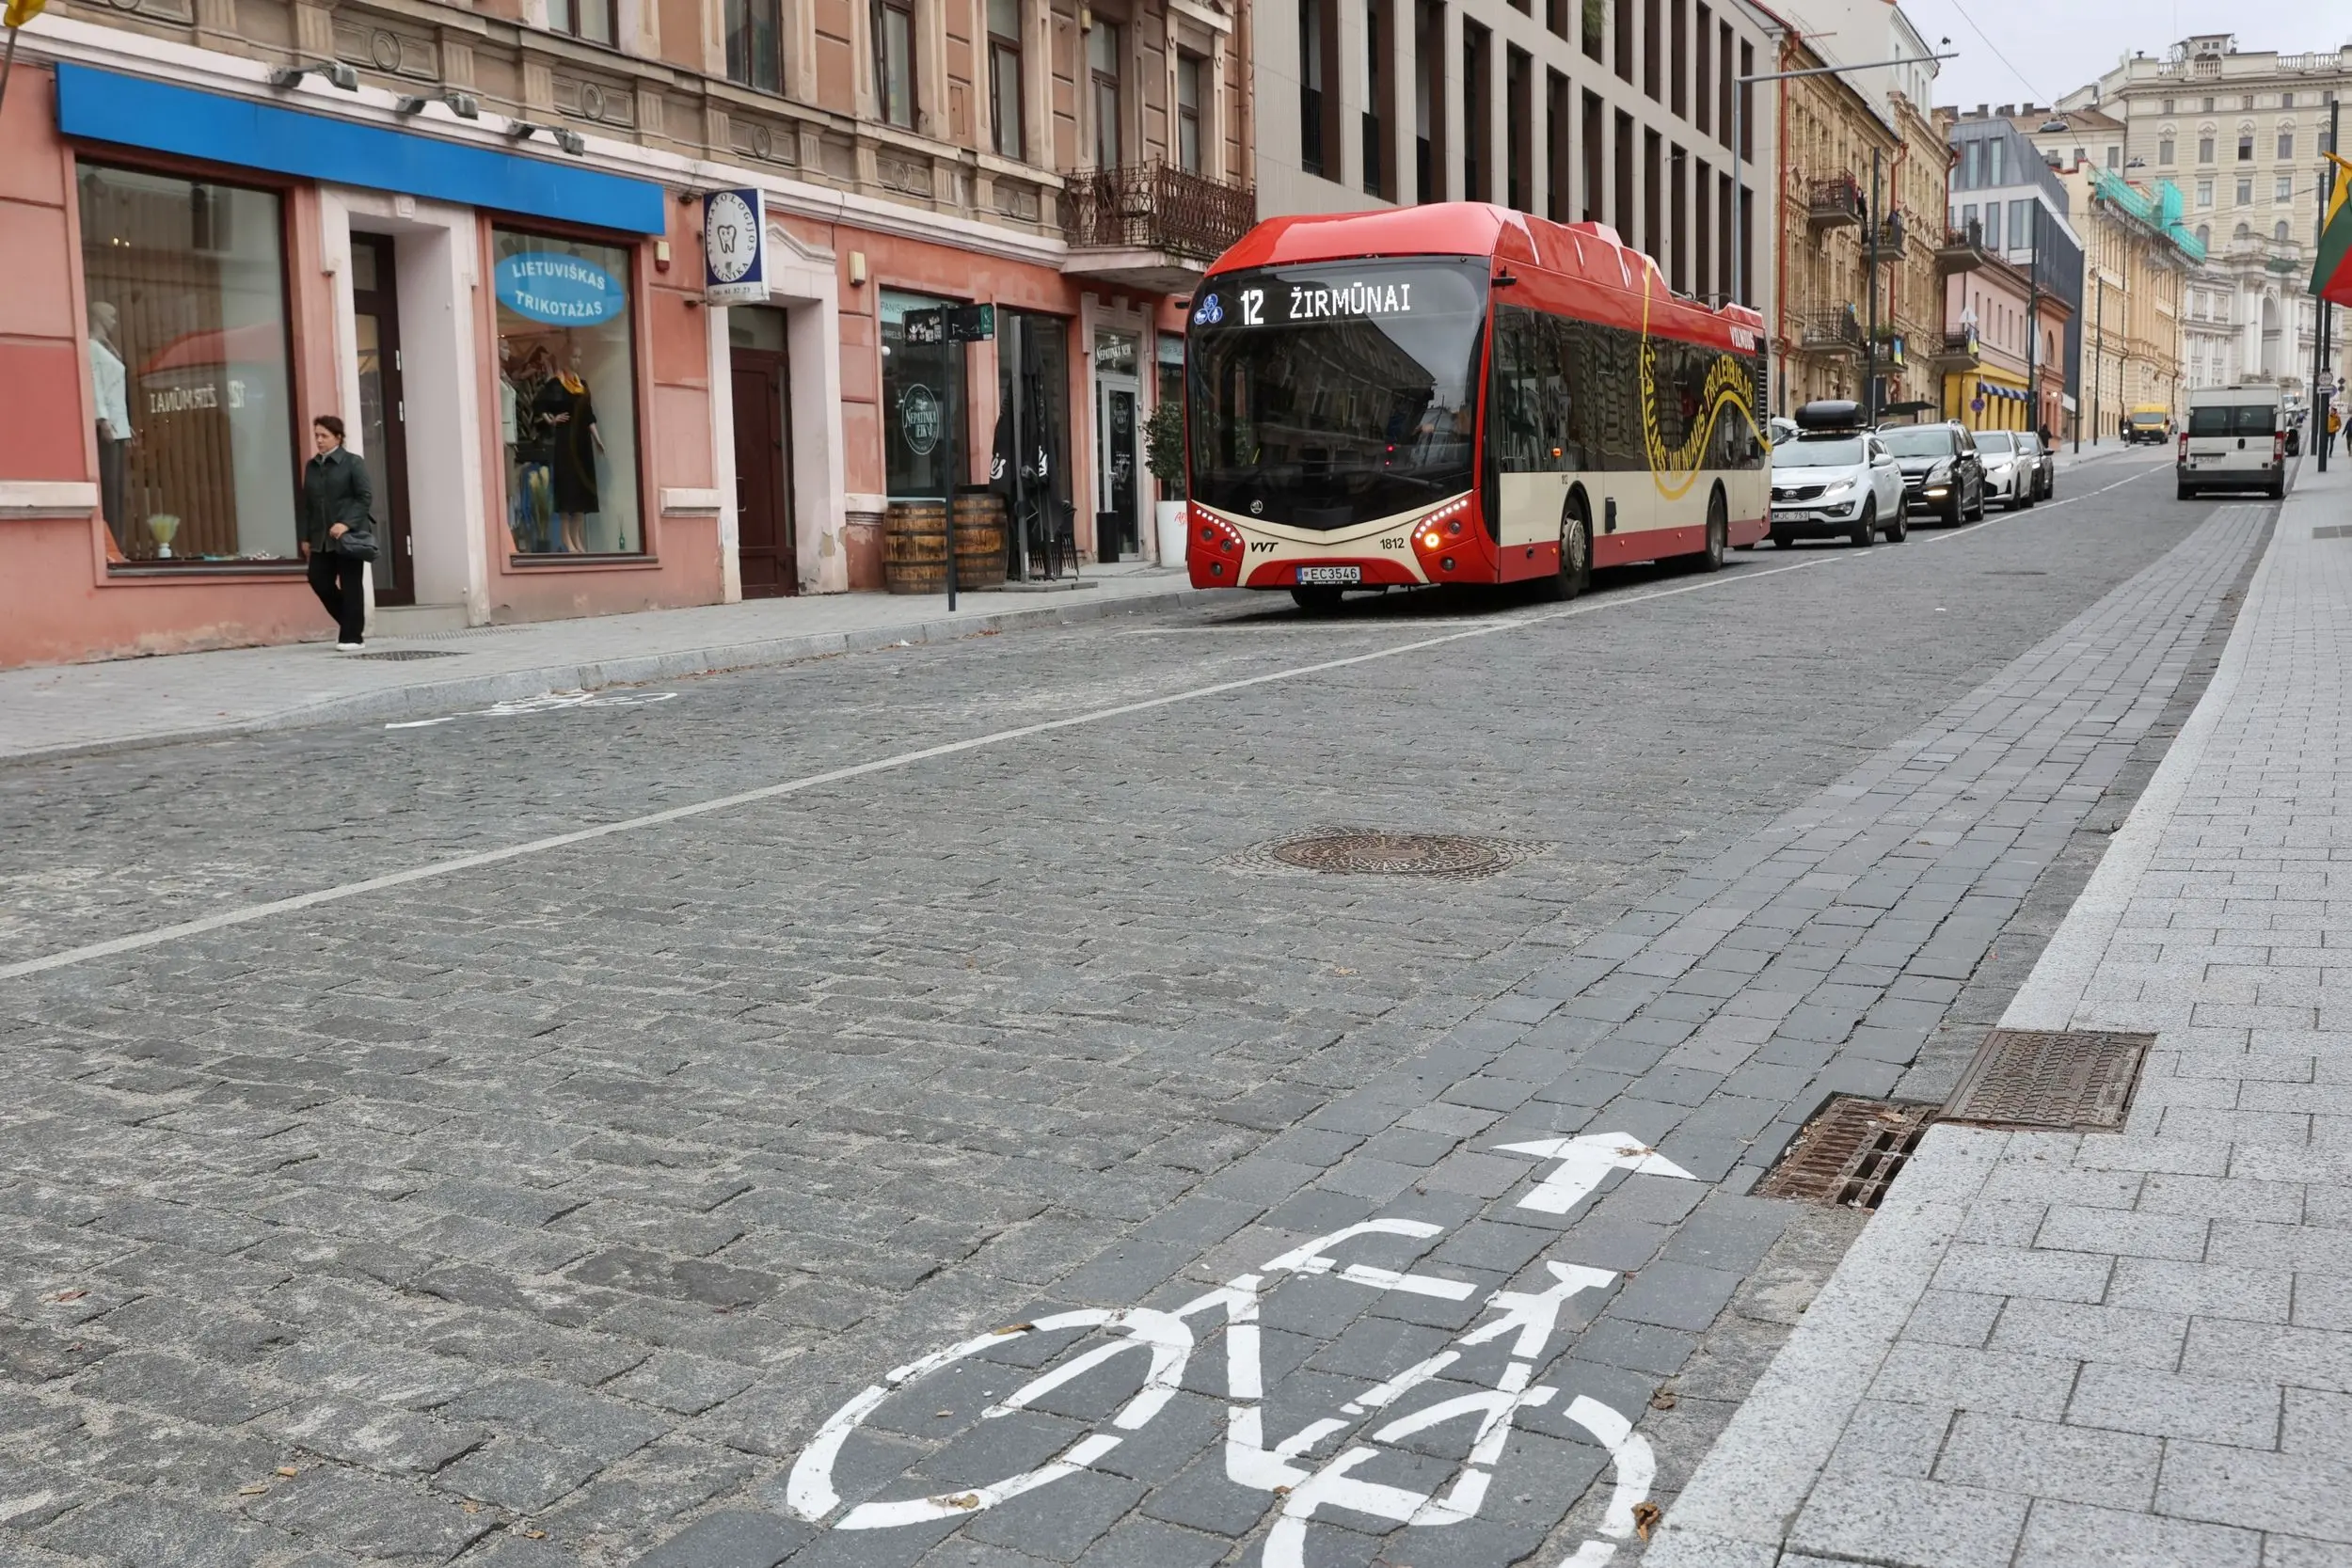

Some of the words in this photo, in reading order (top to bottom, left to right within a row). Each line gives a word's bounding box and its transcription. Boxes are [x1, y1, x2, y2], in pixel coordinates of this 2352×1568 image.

[512, 261, 606, 290] LIETUVIŠKAS
[712, 262, 749, 280] KLINIKA
[516, 290, 603, 317] TRIKOTAŽAS
[1240, 289, 1264, 325] 12
[1290, 282, 1410, 319] ŽIRMŪNAI
[1729, 325, 1756, 351] VILNIUS
[1669, 404, 1706, 481] VILNIAUS
[1704, 353, 1754, 412] TROLEIBUSAS
[1250, 542, 1279, 553] VVT
[1379, 537, 1405, 550] 1812
[1311, 567, 1358, 580] EC3546
